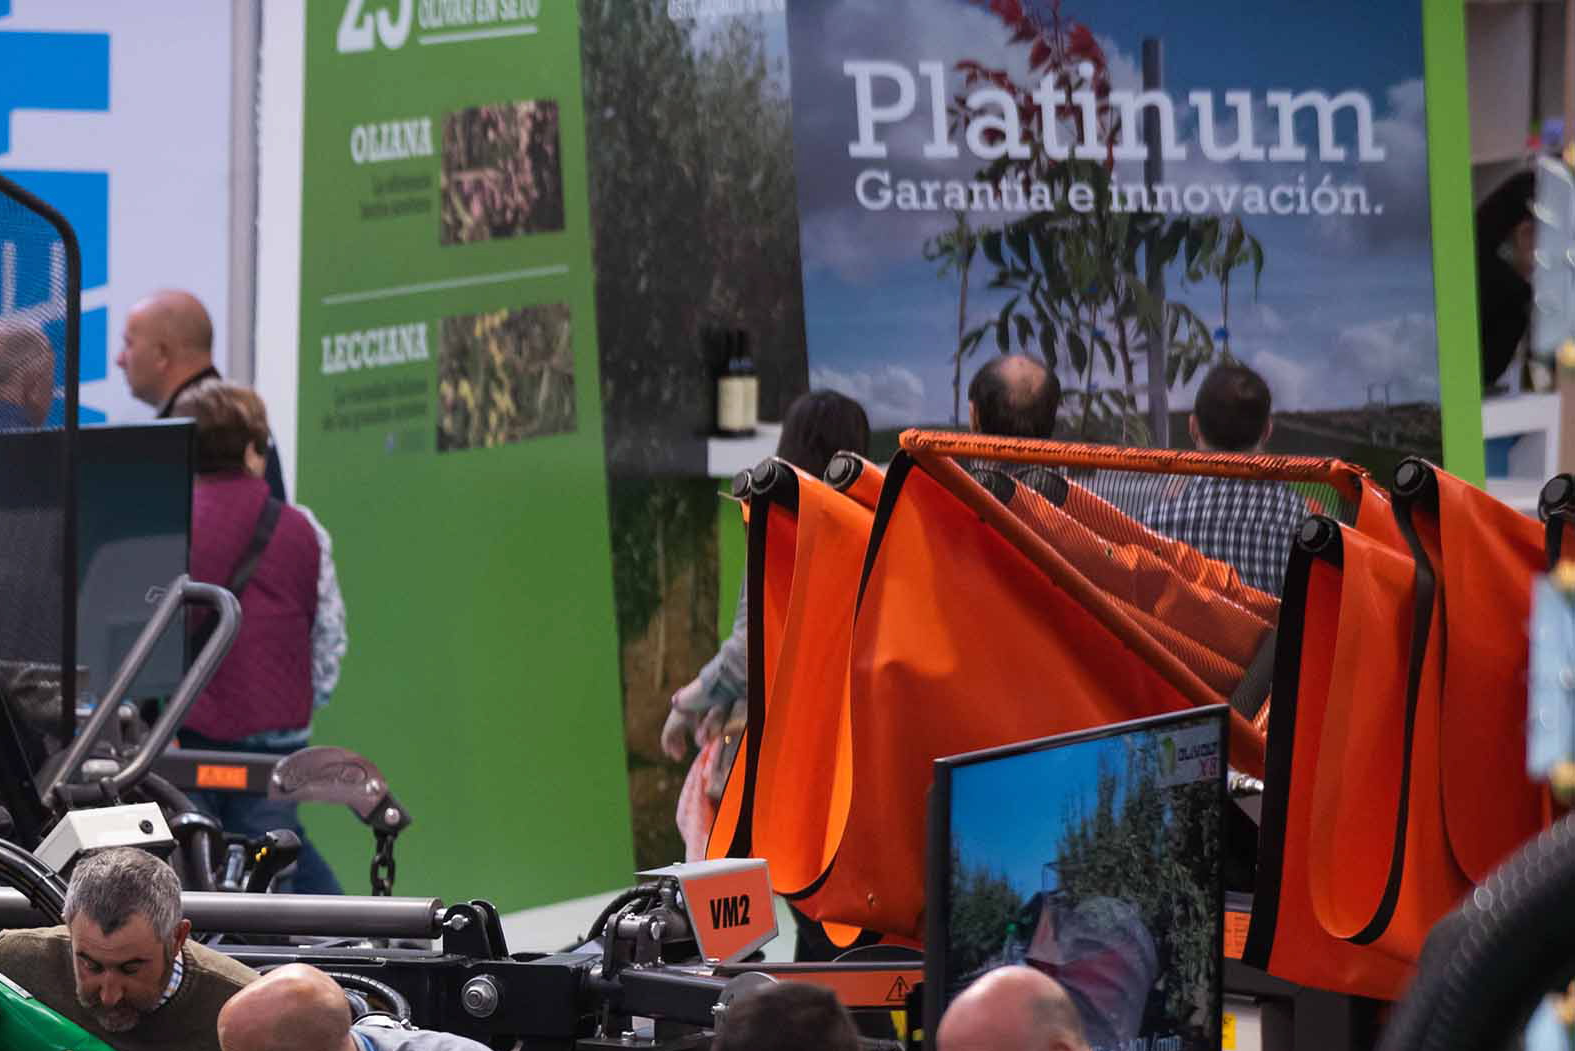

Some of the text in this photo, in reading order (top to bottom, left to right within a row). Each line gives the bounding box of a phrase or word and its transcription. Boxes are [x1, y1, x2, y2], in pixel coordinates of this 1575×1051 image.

[843, 60, 1385, 162] Platinum
[350, 117, 432, 164] OLIANA
[855, 169, 1383, 216] Garantía e innovación.
[321, 323, 429, 375] LECCIANA
[710, 894, 751, 929] VM2
